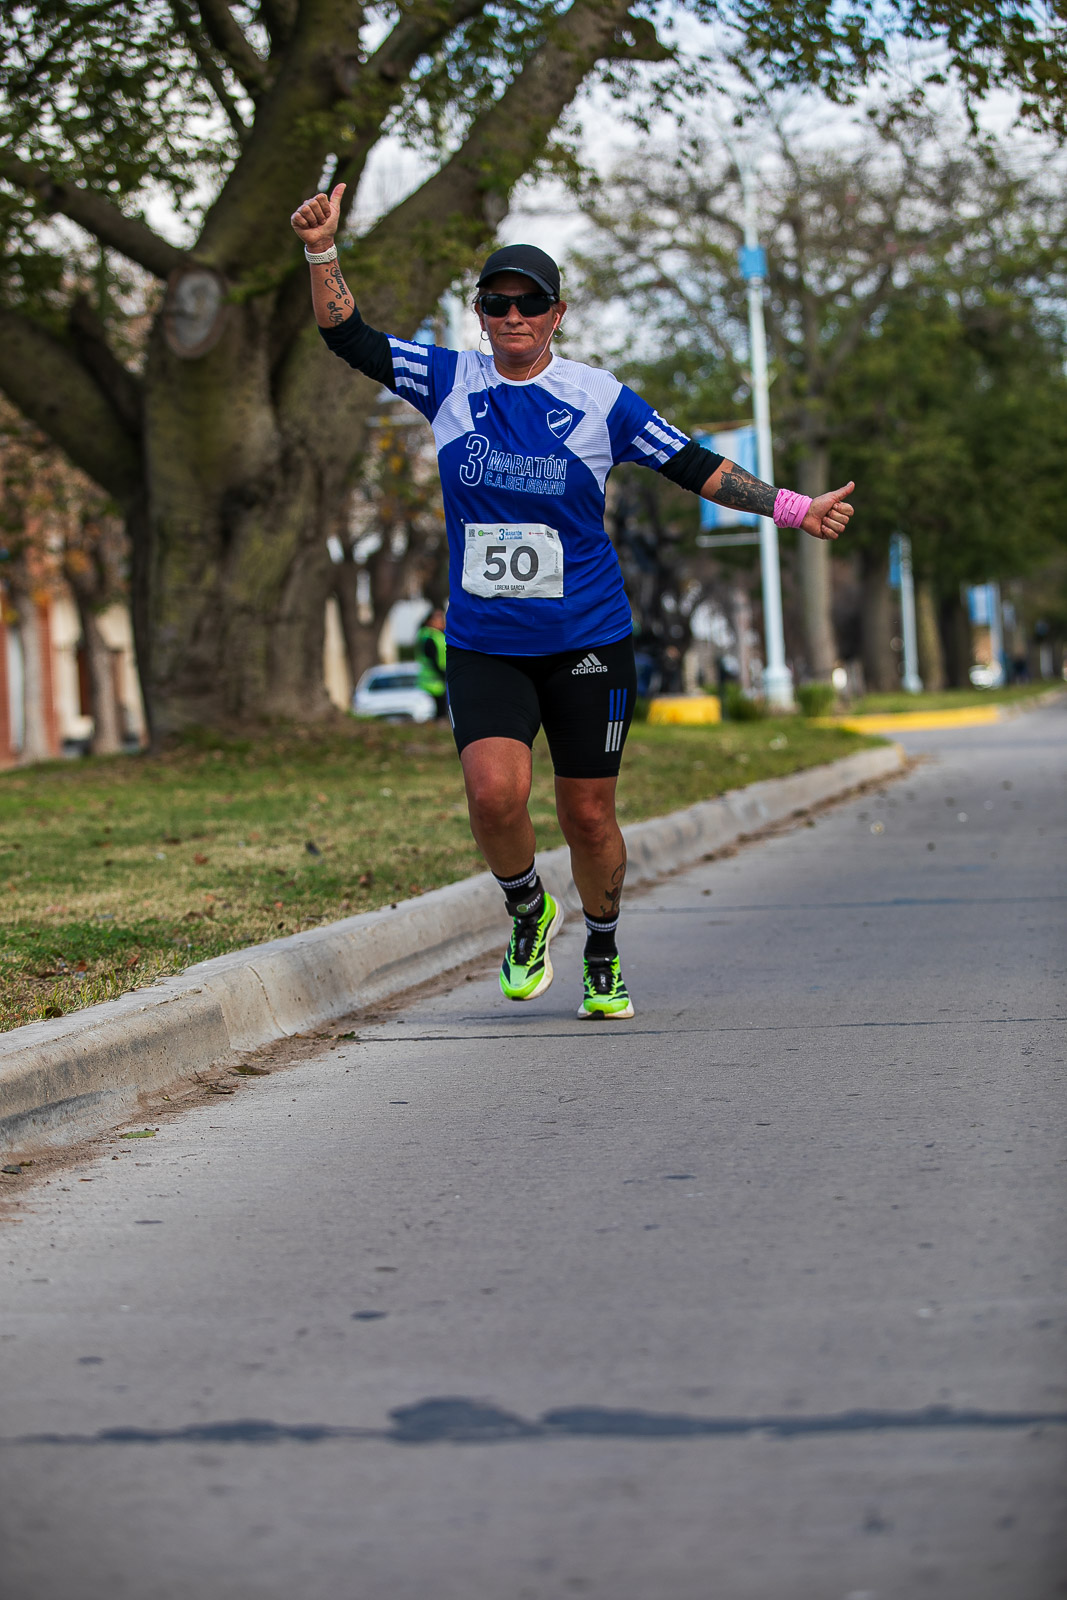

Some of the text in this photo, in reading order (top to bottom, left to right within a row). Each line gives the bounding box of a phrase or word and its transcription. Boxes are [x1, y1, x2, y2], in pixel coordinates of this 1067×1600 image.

[459, 433, 490, 487] 3
[486, 449, 568, 480] MARATÓN
[499, 528, 505, 541] 3
[483, 545, 539, 581] 50
[571, 665, 608, 675] adidas
